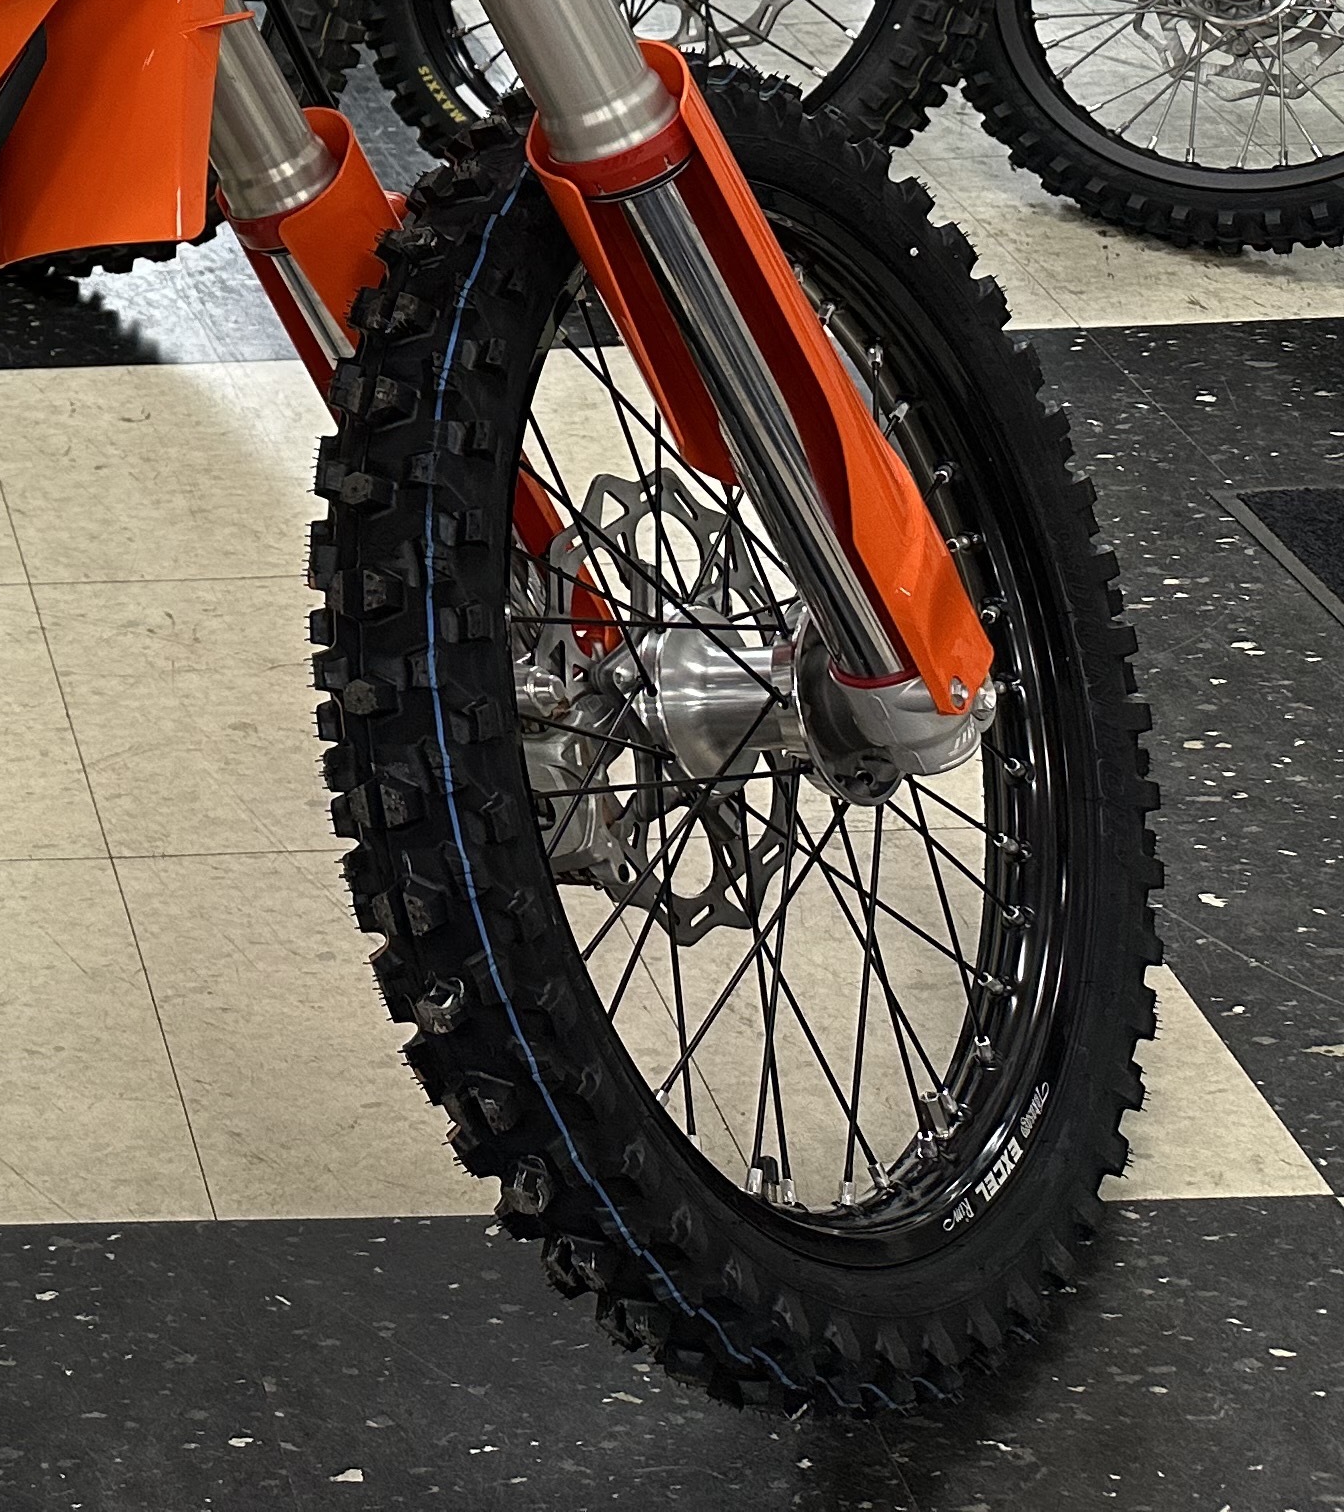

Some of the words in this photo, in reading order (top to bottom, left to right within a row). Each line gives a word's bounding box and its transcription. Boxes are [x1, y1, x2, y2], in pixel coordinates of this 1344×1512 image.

[418, 66, 467, 123] MAXXIS
[975, 1136, 1024, 1202] EXCEL
[942, 1197, 975, 1232] Rim
